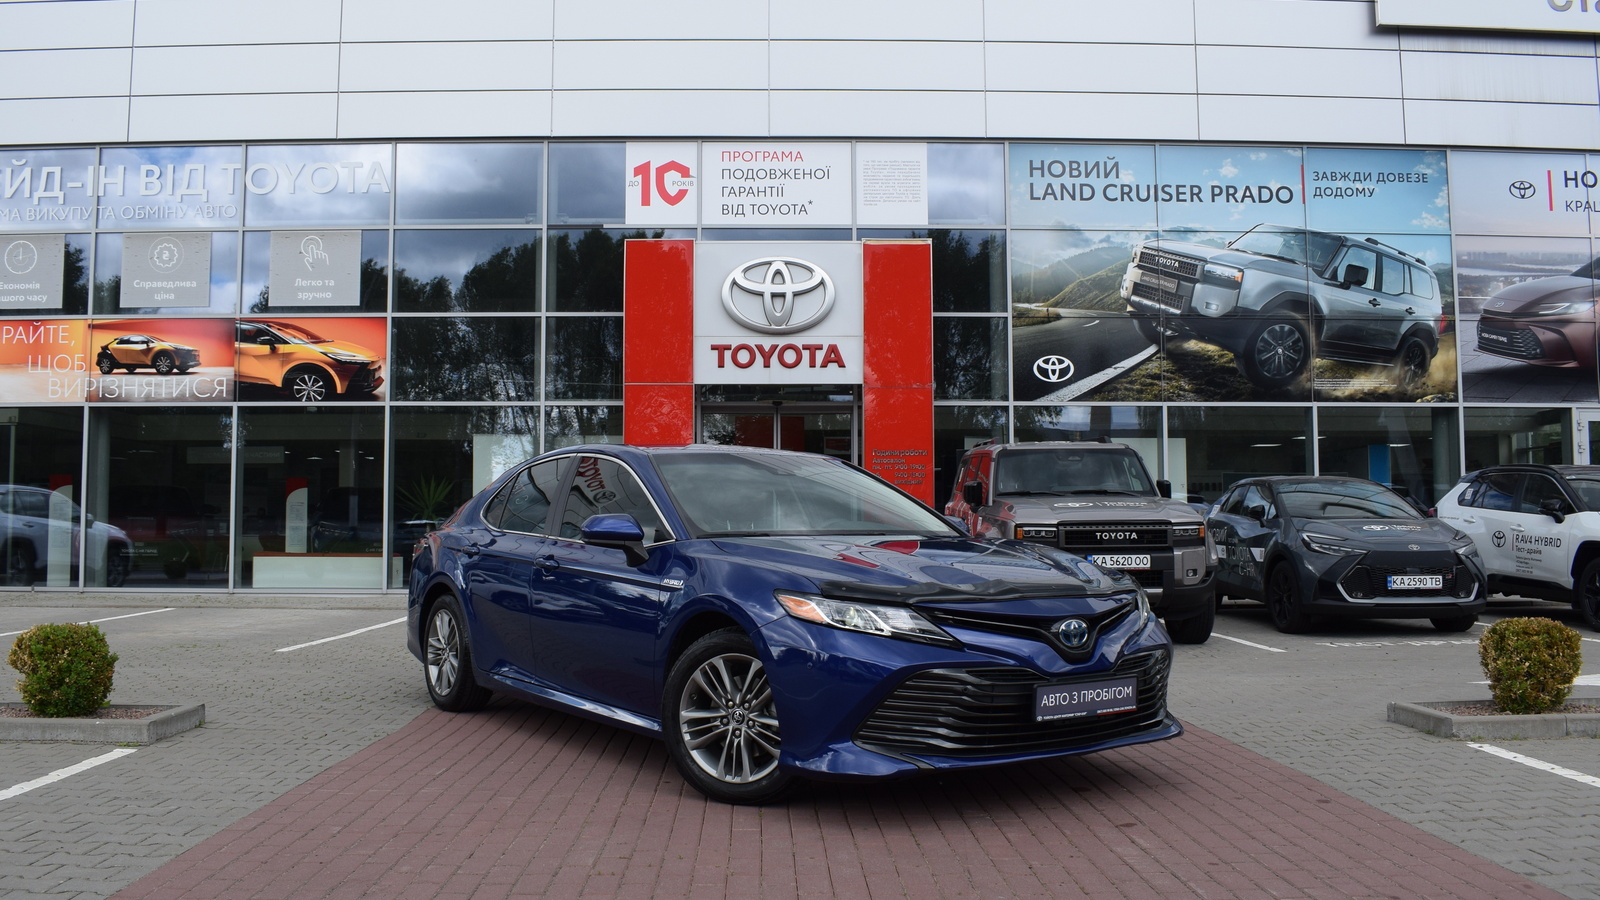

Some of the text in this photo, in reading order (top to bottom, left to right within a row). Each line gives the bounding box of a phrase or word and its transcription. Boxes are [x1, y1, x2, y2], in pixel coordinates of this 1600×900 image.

[721, 151, 804, 162] ПРОГРАМА
[721, 165, 831, 182] ПОДОВЖЕНОЇ
[1029, 156, 1120, 179] НОВИЙ
[0, 158, 391, 205] ЙД-ІН ВІД TOYOTA
[1312, 171, 1429, 184] ЗАВЖДИ ДОВЕЗЕ
[721, 183, 786, 197] ГАРАНТІЇ
[1029, 182, 1294, 204] LAND CRUISER PRADO
[1313, 186, 1376, 199] ДОДОМУ
[26, 206, 93, 221] ВИКУПУ
[97, 205, 117, 220] ТА
[120, 205, 189, 220] ОБМІНУ
[193, 204, 238, 219] АВТО
[721, 203, 746, 218] ВІД
[1155, 256, 1179, 268] TOYOTA
[133, 280, 197, 290] Справедлива
[294, 278, 335, 287] Легко та
[26, 294, 48, 303] часу
[154, 291, 175, 301] ціна
[297, 291, 332, 300] зручно
[1, 321, 75, 347] РАЙТЕ,
[710, 343, 846, 369] TOYOTA
[27, 354, 87, 376] ЩОБ
[48, 377, 227, 399] ВИРІЗНЯТИСЯ
[900, 448, 928, 457] роботи
[1095, 532, 1138, 540] TOYOTA
[1515, 533, 1562, 548] RAV4 HYBRID
[1228, 546, 1252, 561] TOYOTA
[1515, 546, 1542, 556] Тест-драйв
[1092, 557, 1108, 566] KA
[1109, 557, 1133, 566] 5620
[1238, 562, 1256, 576] C-HR
[1392, 577, 1441, 586] KA 2590 TB
[1041, 692, 1070, 707] АВТО
[1080, 686, 1132, 702] ПРОБІГОМ
